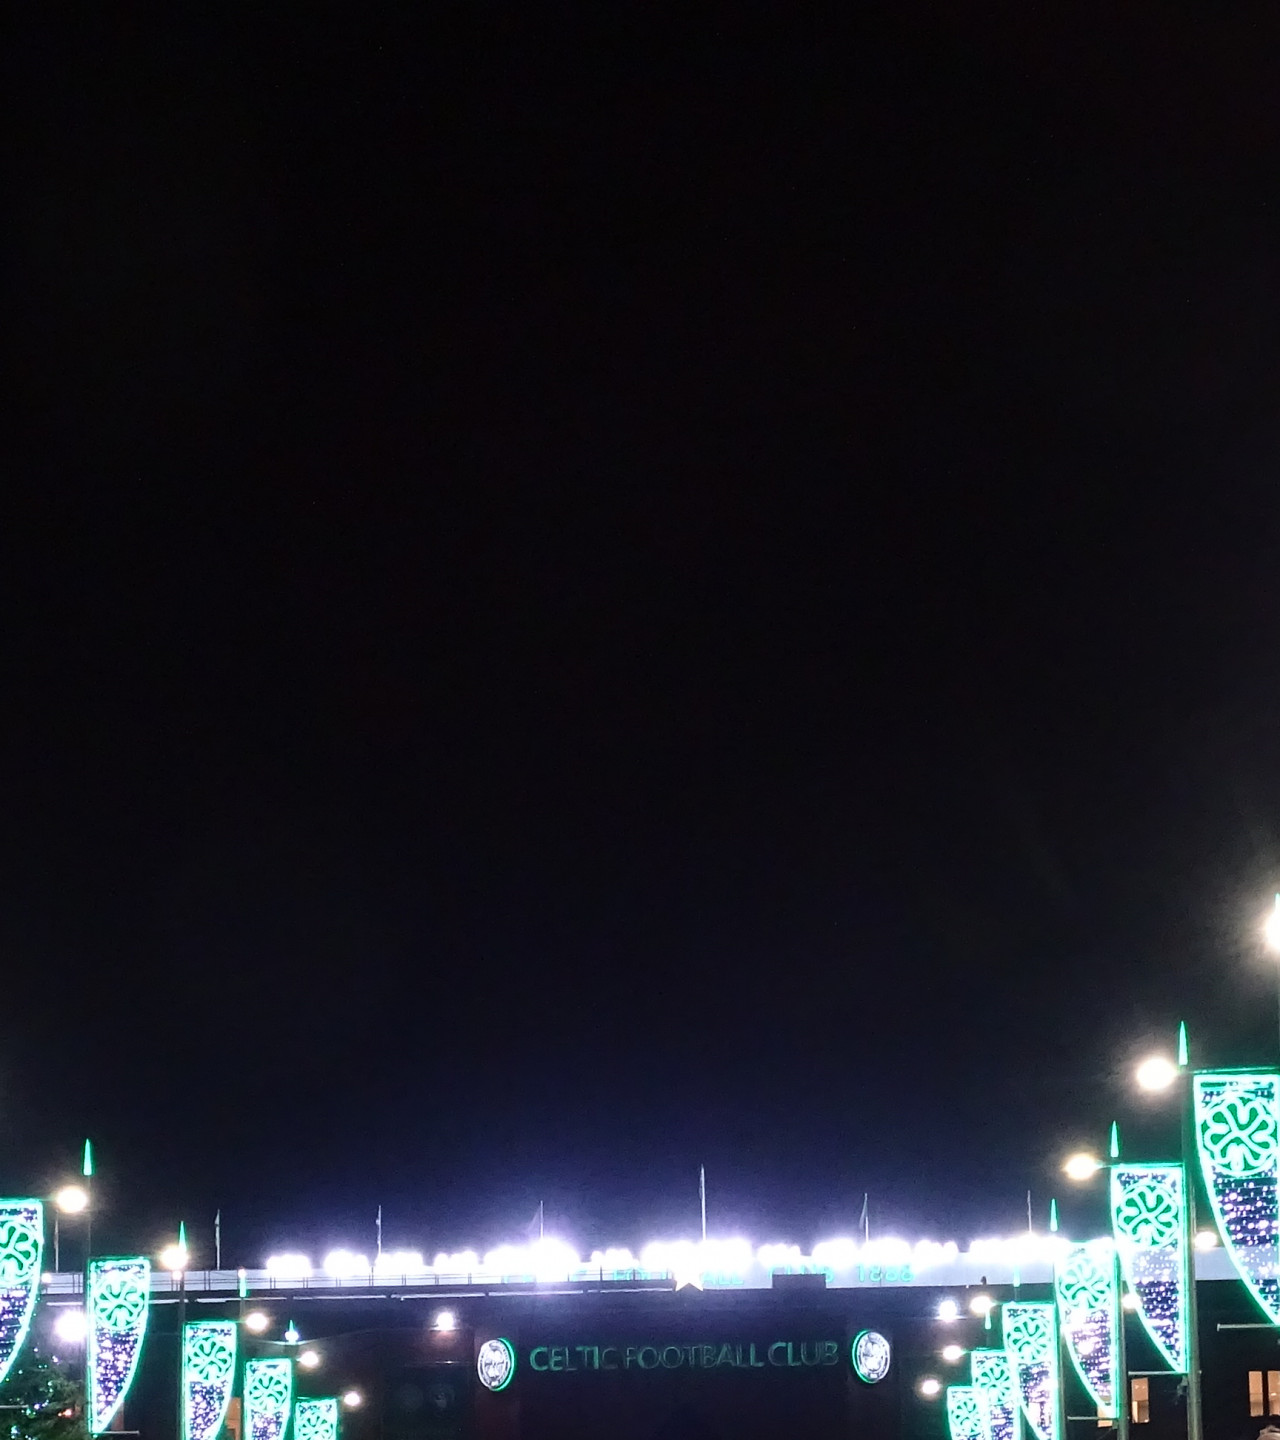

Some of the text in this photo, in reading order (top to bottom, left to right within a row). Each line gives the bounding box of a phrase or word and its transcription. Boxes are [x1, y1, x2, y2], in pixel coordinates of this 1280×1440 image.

[529, 1345, 619, 1371] CELTIC
[623, 1342, 765, 1369] FOOTBALL
[768, 1341, 840, 1367] CLUB
